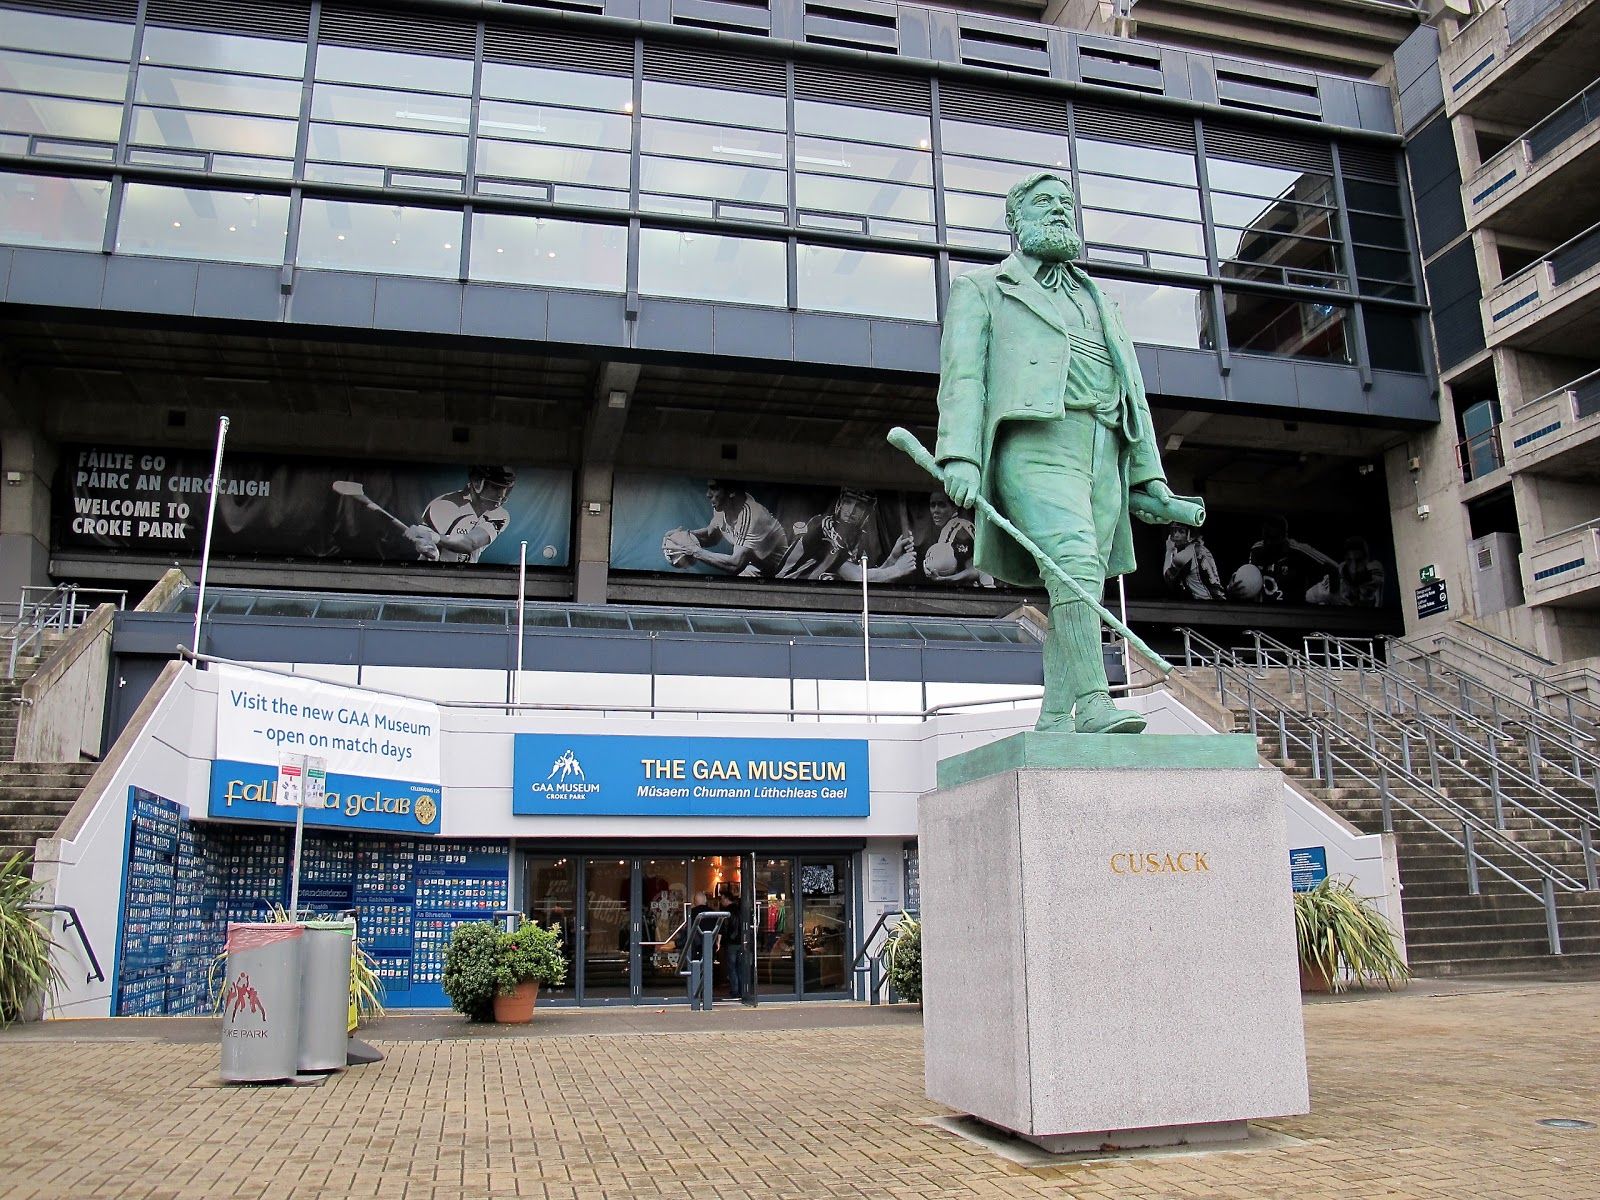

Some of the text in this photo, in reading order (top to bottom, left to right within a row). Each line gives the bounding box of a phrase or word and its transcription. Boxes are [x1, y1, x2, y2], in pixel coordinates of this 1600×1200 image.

[78, 449, 165, 471] FÁILTE GO
[76, 467, 129, 489] PÁIRC
[136, 474, 161, 491] AN
[74, 498, 190, 519] WELCOME TO
[72, 517, 186, 539] CROKE PARK
[231, 690, 431, 736] Visit the new GAA Museum
[266, 728, 304, 746] open
[309, 734, 328, 748] on
[332, 737, 378, 755] match
[381, 740, 412, 762] days
[641, 759, 846, 781] THE GAA MUSEUM
[532, 783, 600, 793] GAA MUSEUM
[637, 785, 848, 799] Músaem Chumann Lúthchleas Gael
[1110, 852, 1209, 873] CUSACK
[240, 1029, 268, 1039] PARK
